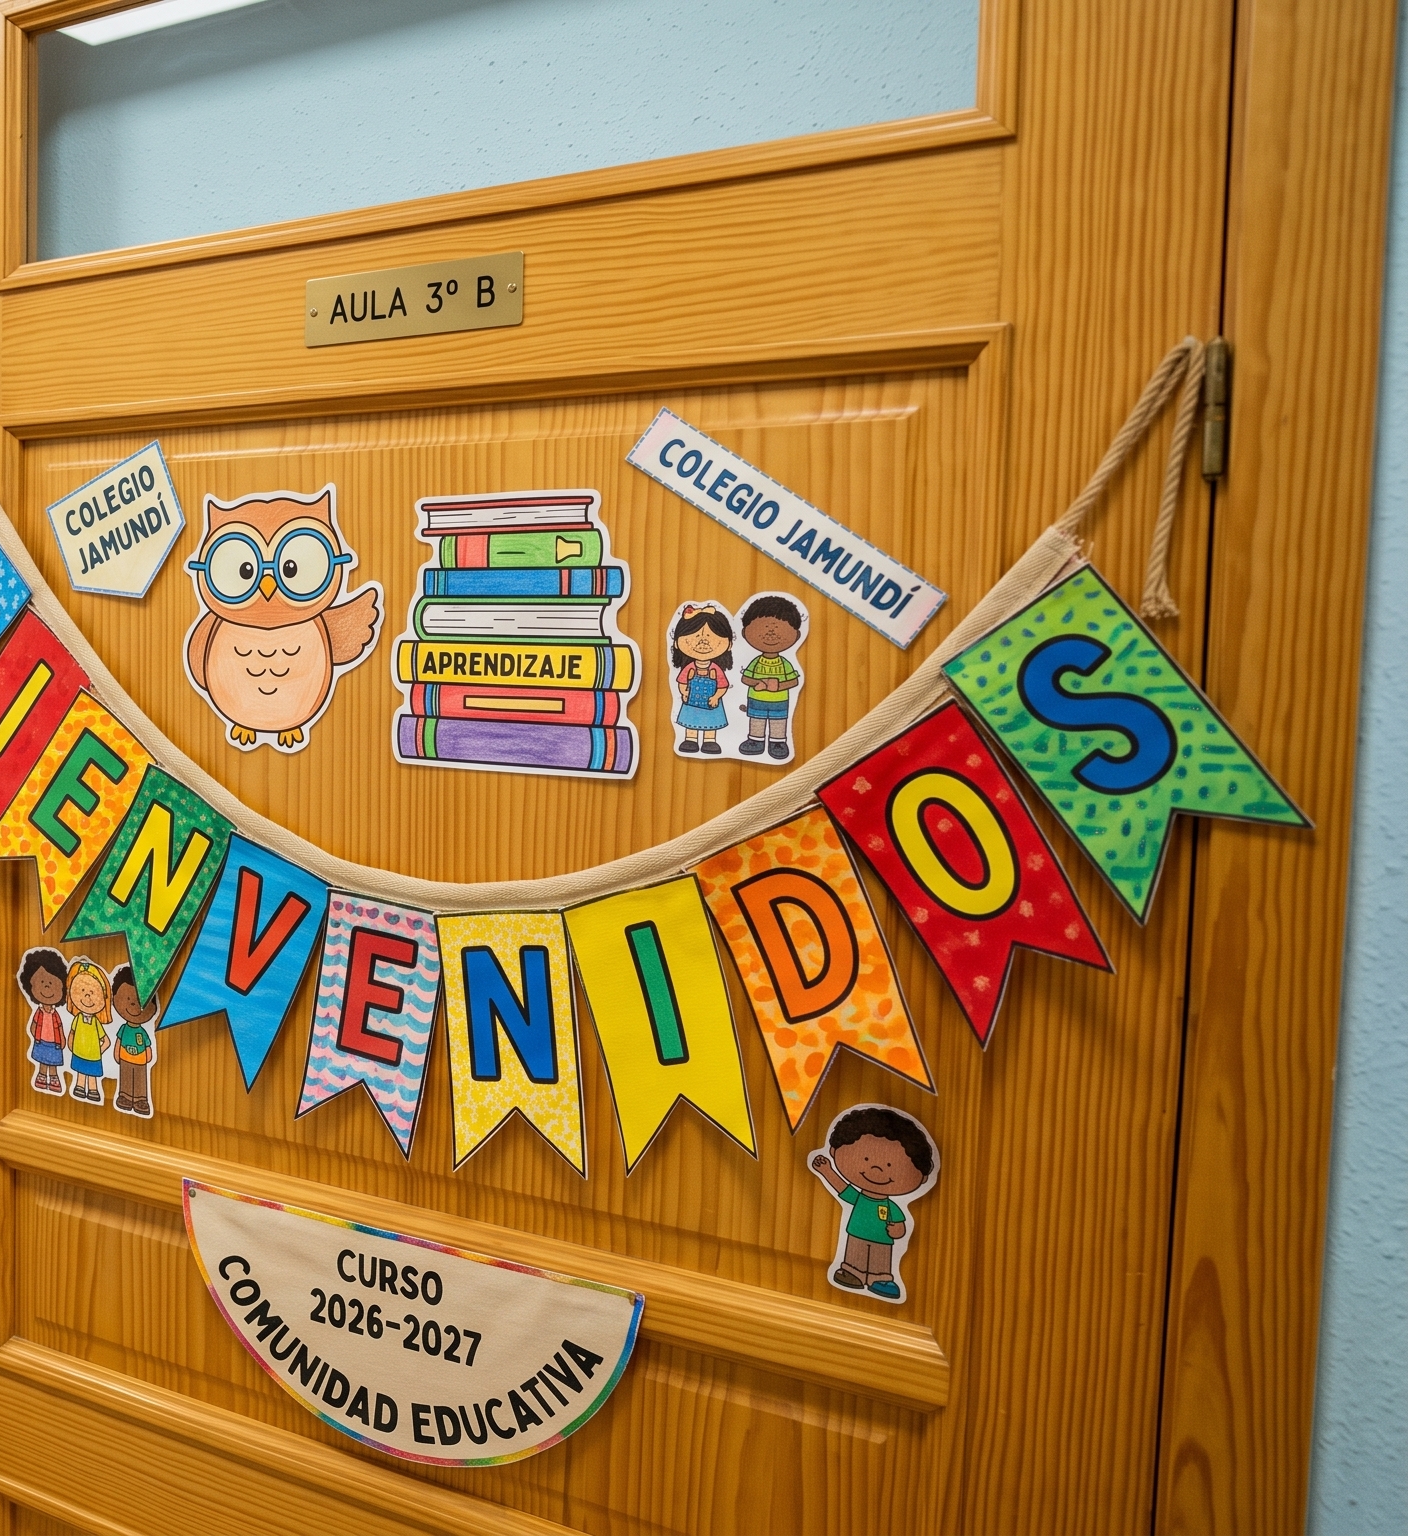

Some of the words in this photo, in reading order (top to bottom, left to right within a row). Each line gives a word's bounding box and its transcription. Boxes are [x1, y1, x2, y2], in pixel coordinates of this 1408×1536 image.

[329, 286, 407, 325] AULA
[425, 279, 458, 314] 3º
[476, 275, 496, 309] B
[65, 465, 155, 536] COLEGIO
[78, 491, 171, 575] JAMUNDÍ
[658, 438, 780, 530] COLEGIO
[776, 519, 922, 620] JAMUNDÍ
[422, 651, 583, 680] APRENDIZAJE
[336, 1248, 443, 1306] CURSO
[217, 1254, 399, 1434] COMUNIDAD
[411, 1338, 605, 1447] EDUCATIVA
[309, 1287, 483, 1367] 2026-2027
